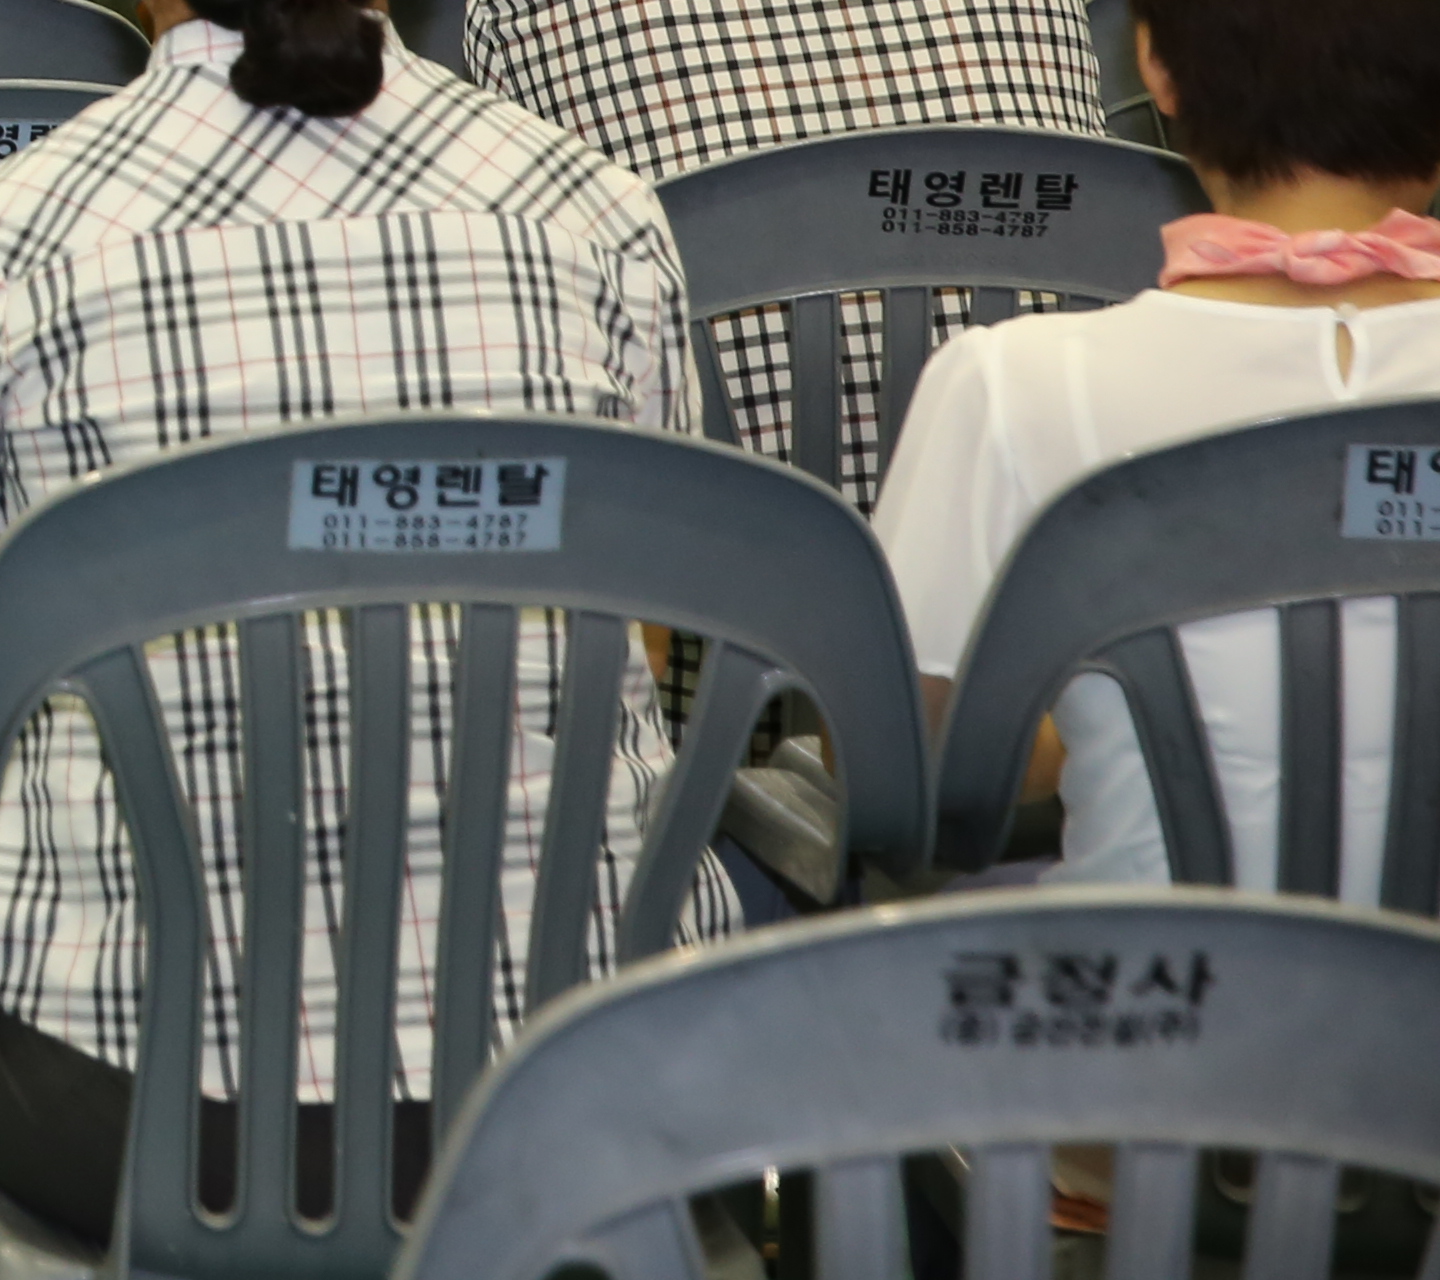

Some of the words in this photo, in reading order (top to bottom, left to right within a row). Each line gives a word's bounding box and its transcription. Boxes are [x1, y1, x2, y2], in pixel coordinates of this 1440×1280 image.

[867, 169, 1079, 211] 태영렌탈
[882, 207, 1050, 223] 011-883-4787
[881, 220, 1049, 237] 011-858-4787
[311, 462, 551, 511] 태영렌탈
[322, 514, 530, 530] 011-883-4787
